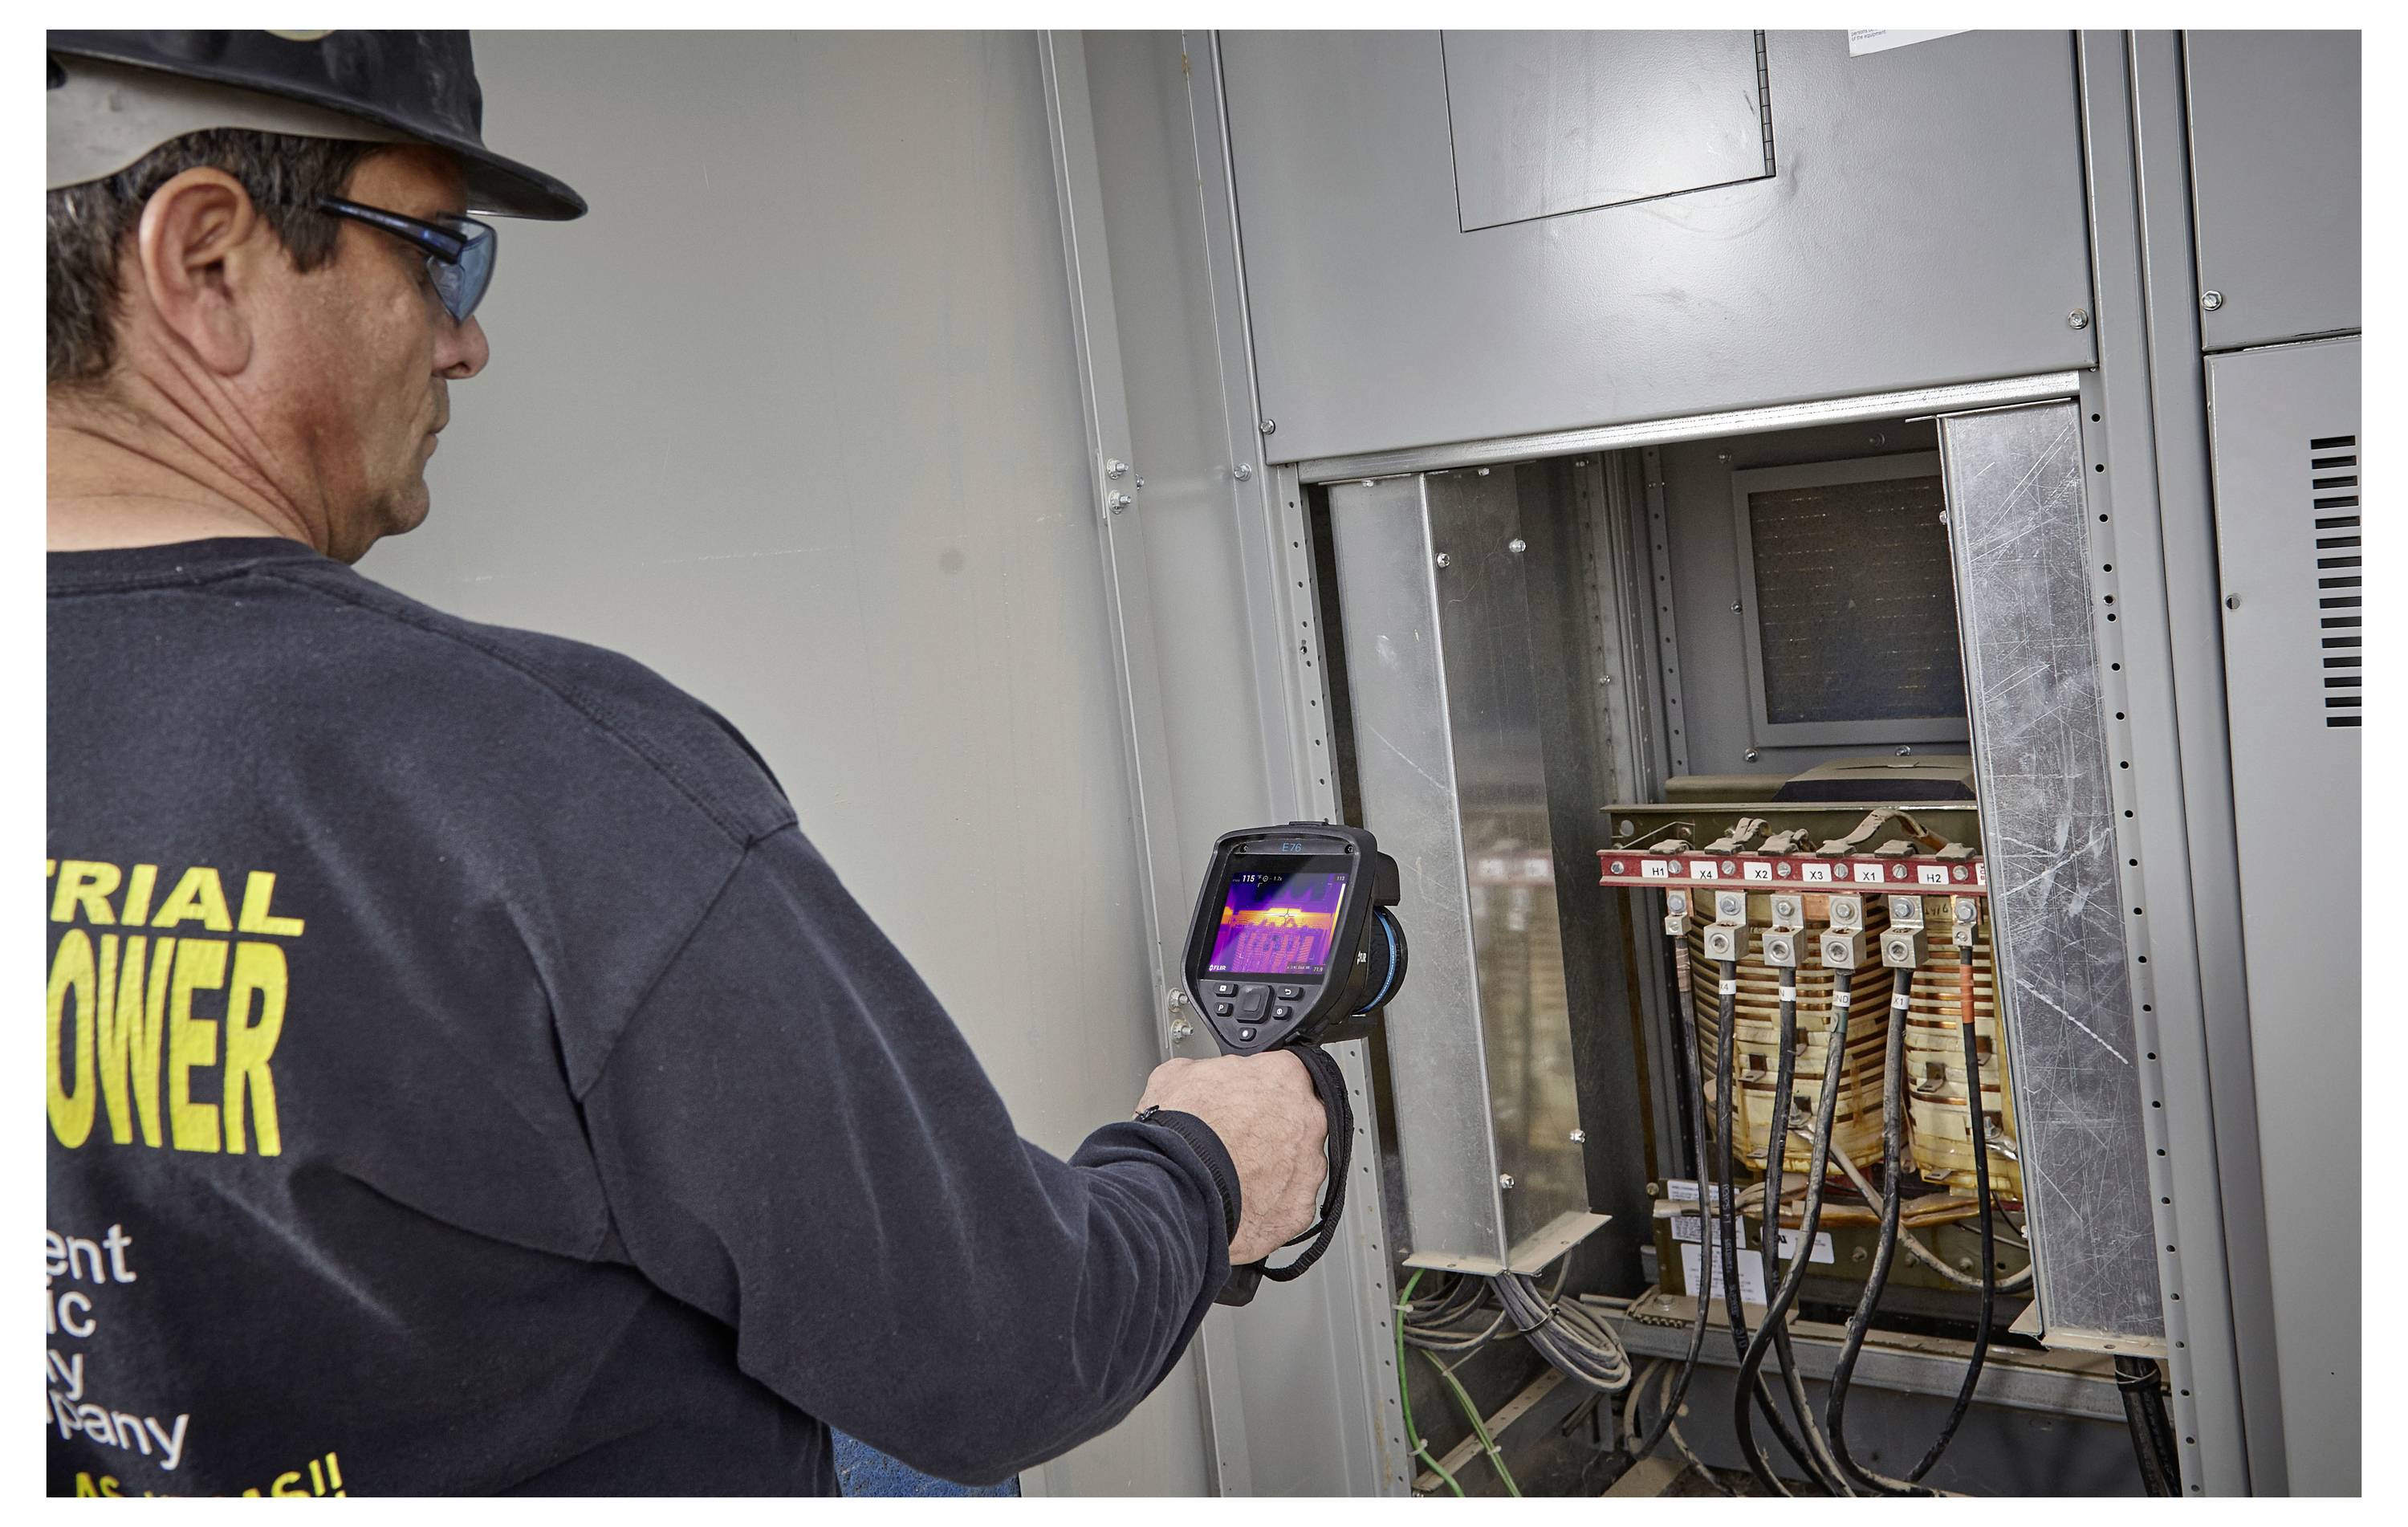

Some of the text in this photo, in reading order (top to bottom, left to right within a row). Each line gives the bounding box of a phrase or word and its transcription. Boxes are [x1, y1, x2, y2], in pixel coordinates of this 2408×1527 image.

[1282, 843, 1302, 852] E76
[1652, 868, 1665, 876] H1
[1699, 870, 1712, 879] X4
[1755, 870, 1768, 879] X2
[1810, 871, 1824, 880] X3
[1862, 872, 1876, 881] X1
[1926, 873, 1942, 882] H2
[47, 859, 305, 937] RIAL
[1893, 996, 1903, 1005] X1
[47, 928, 289, 1157] OWER
[47, 1349, 83, 1401] y
[47, 1390, 190, 1471] pany
